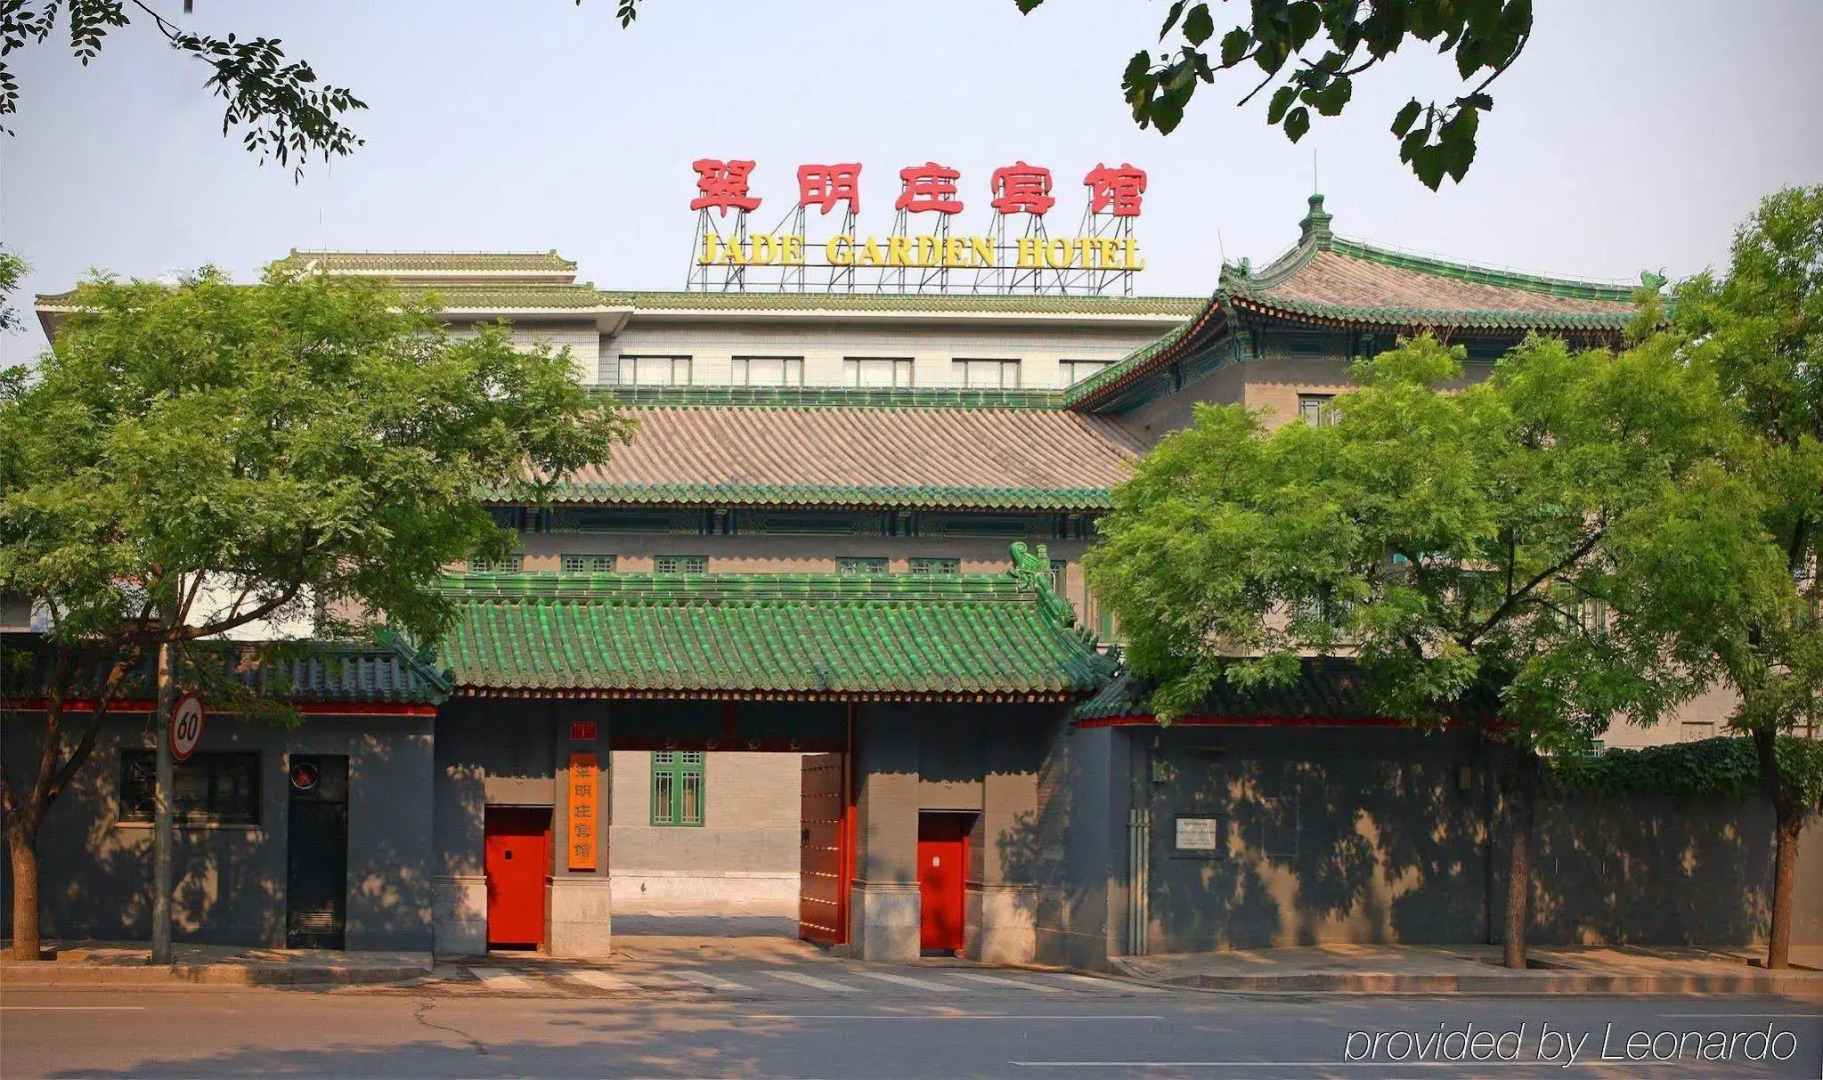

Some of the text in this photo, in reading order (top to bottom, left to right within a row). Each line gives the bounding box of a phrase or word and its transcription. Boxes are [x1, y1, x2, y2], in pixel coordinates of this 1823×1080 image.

[690, 159, 1147, 218] 翠明庄宾馆
[698, 233, 1147, 271] JADE GARDEN HOTEL
[177, 711, 198, 742] 60
